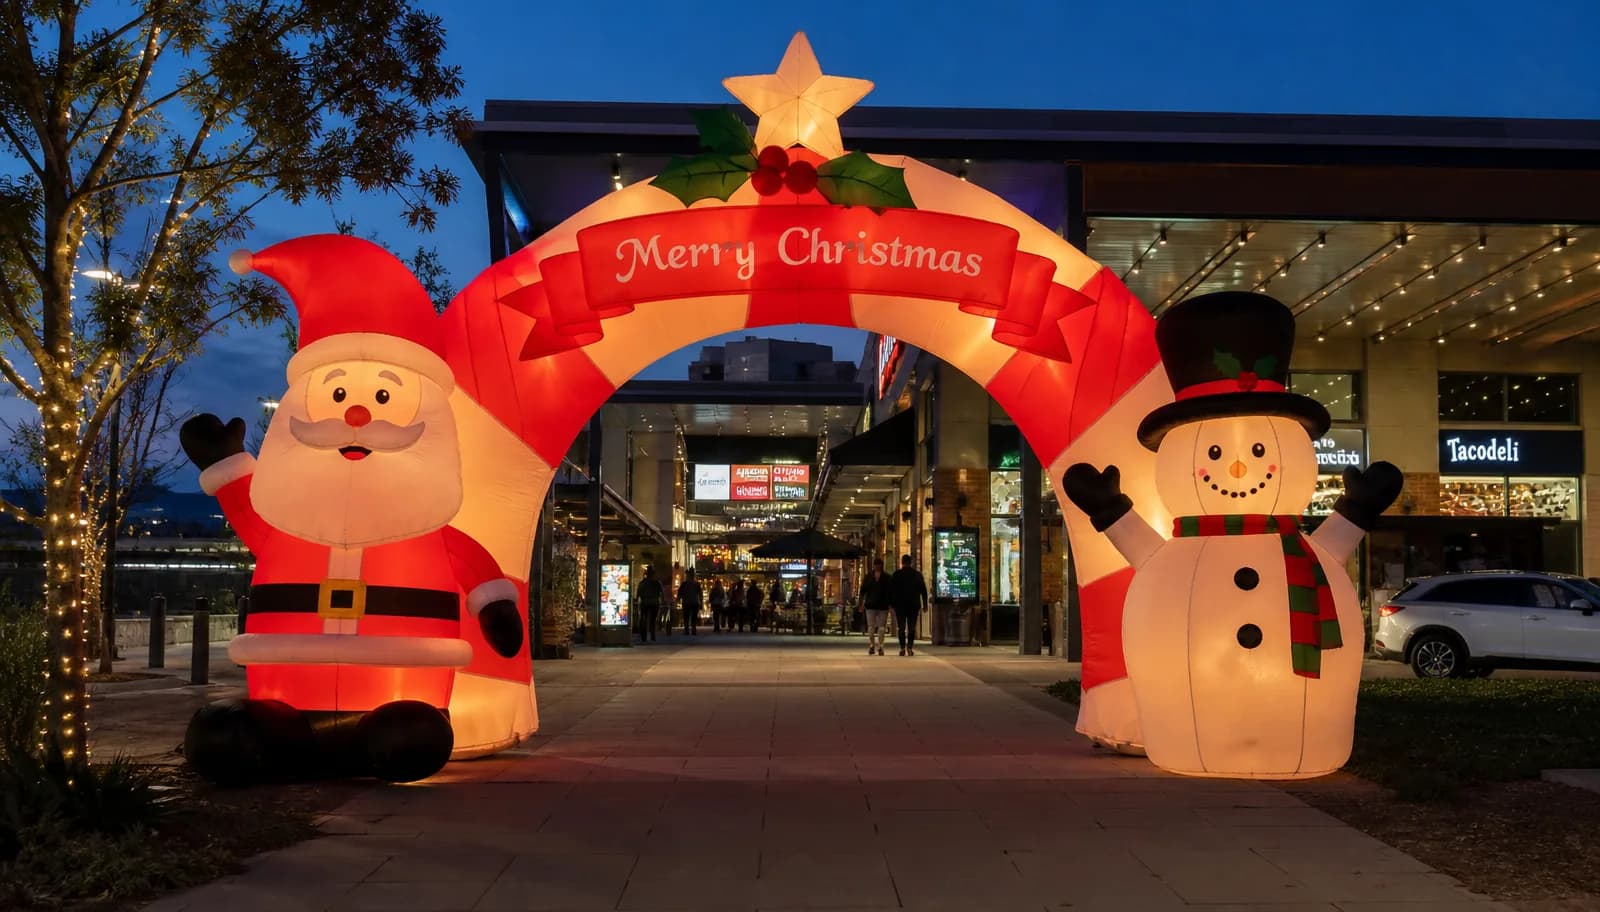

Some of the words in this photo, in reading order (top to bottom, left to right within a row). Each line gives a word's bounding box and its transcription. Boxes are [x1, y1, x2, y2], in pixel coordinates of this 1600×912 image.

[615, 234, 755, 283] Merry
[777, 226, 983, 277] Christmas
[1446, 437, 1519, 462] Tacodeli
